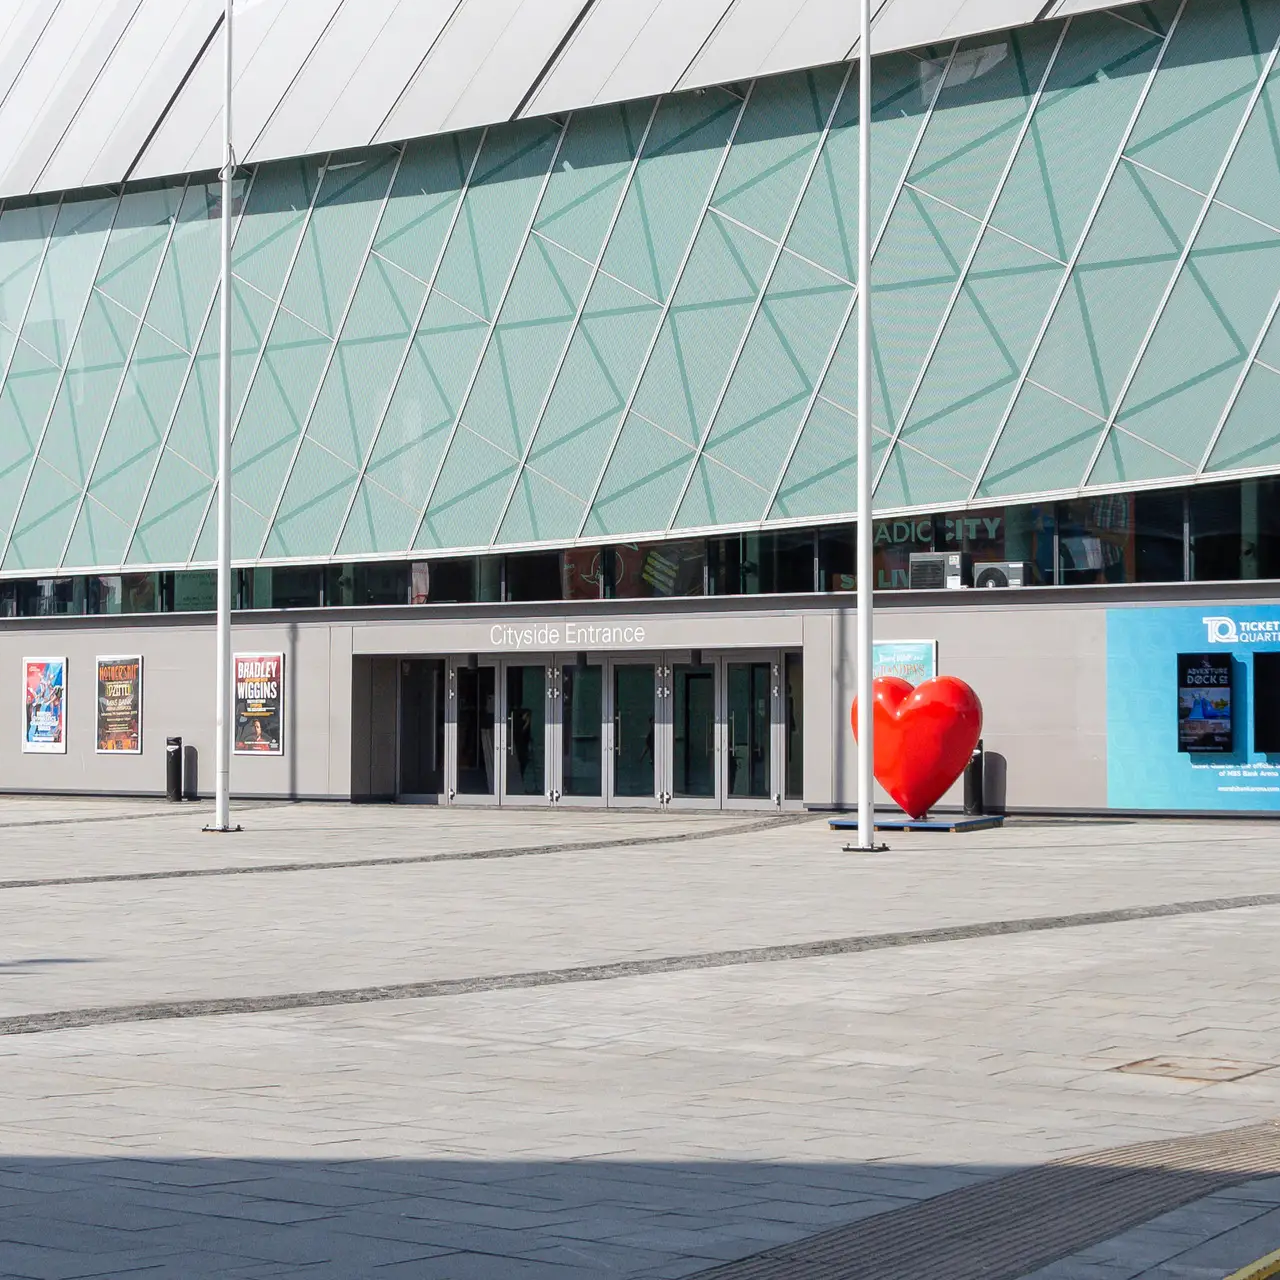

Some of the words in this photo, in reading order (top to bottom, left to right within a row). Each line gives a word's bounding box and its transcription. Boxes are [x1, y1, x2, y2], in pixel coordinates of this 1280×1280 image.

[490, 623, 561, 649] Cityside
[565, 622, 646, 645] Entrance
[1239, 621, 1280, 632] TICKET
[237, 660, 278, 679] BRADLEY
[237, 681, 278, 699] WIGGINS
